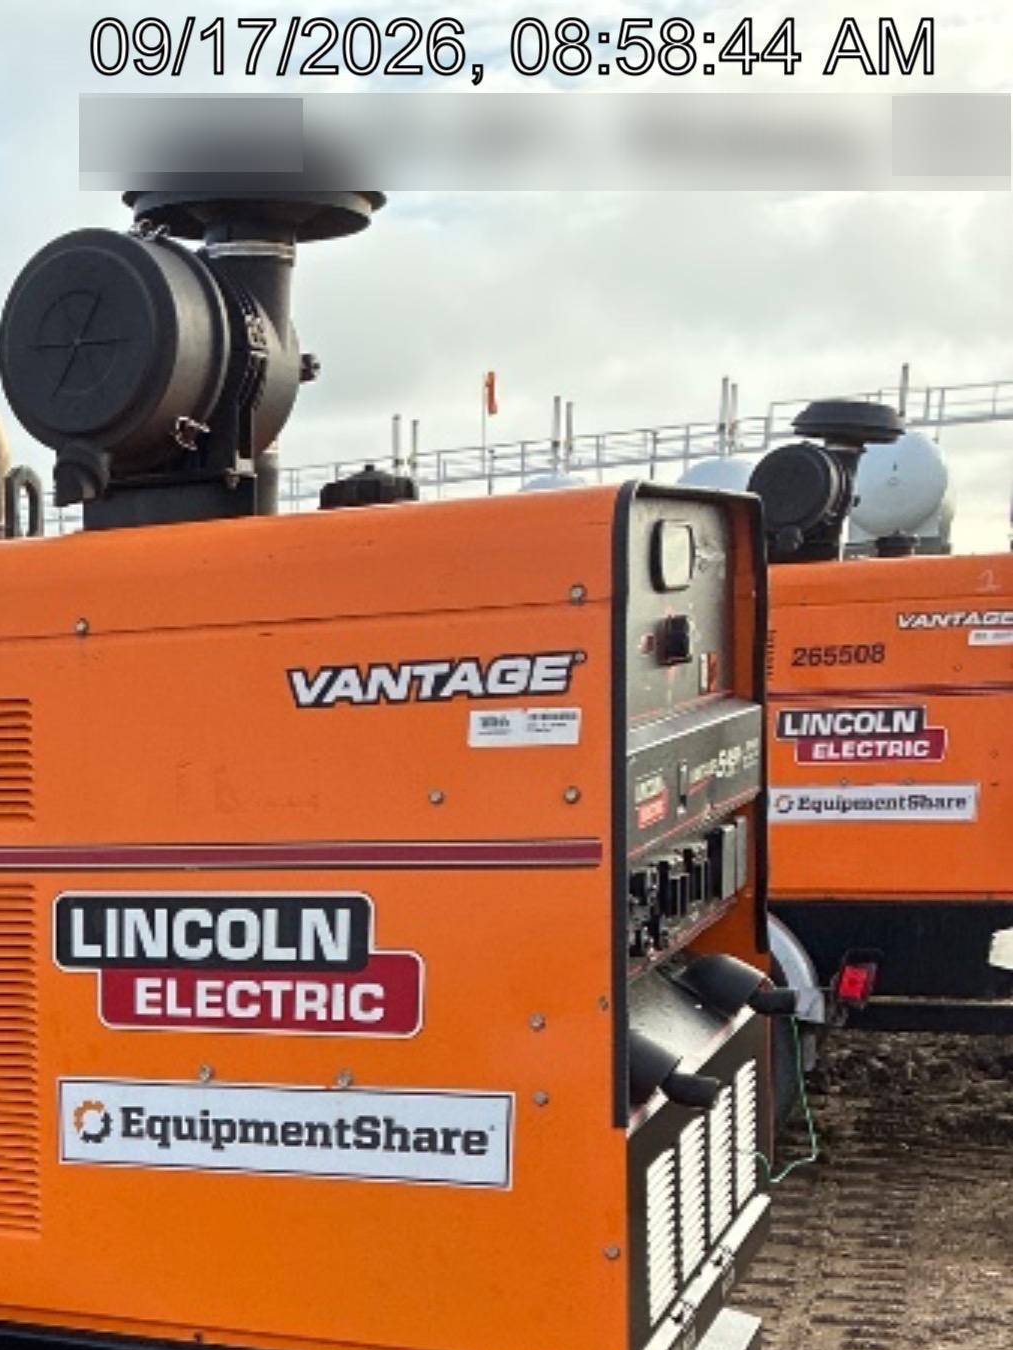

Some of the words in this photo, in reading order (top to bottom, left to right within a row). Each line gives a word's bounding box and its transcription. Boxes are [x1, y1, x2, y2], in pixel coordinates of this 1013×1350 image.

[791, 642, 886, 667] 265508
[288, 653, 575, 706] VANTAGE
[783, 710, 918, 737] LINCOLN
[811, 740, 931, 761] ELECTRIC
[796, 793, 968, 814] EquipmentShare
[70, 907, 352, 962] LINCOLN
[133, 976, 385, 1022] ELECTRIC
[120, 1105, 489, 1156] EquipmentShare
